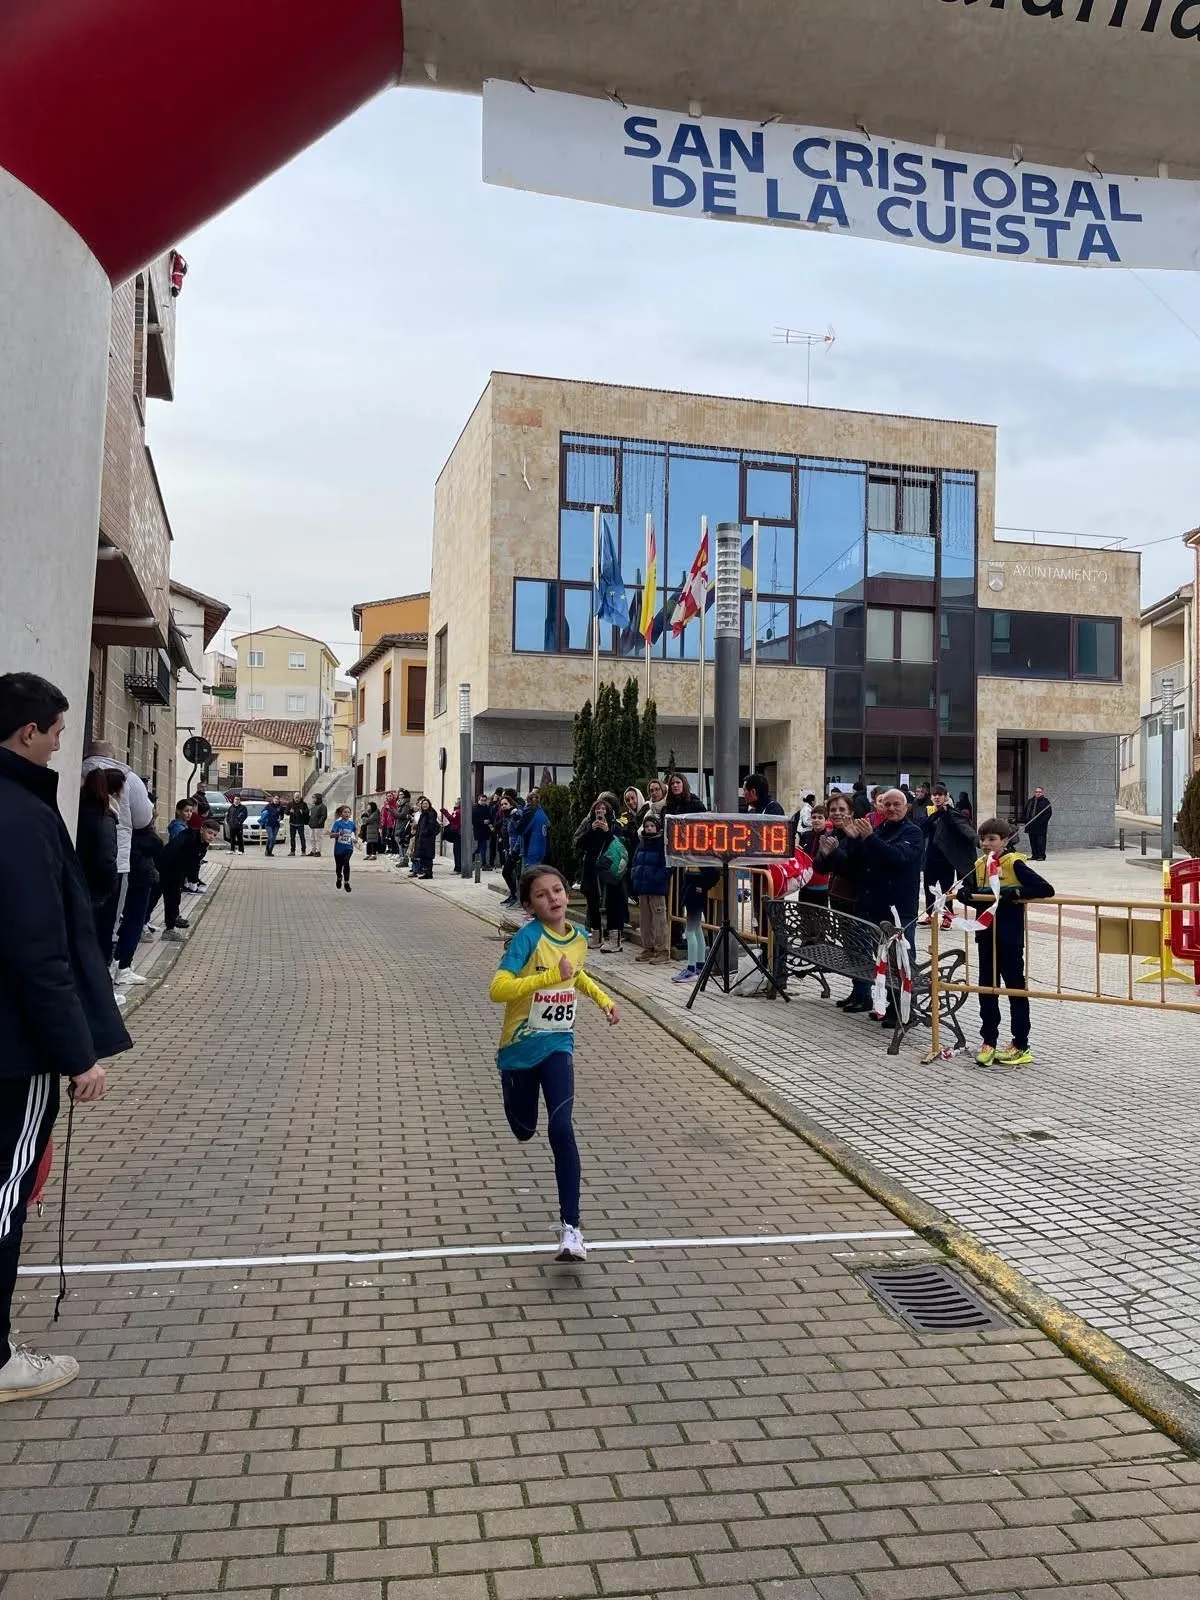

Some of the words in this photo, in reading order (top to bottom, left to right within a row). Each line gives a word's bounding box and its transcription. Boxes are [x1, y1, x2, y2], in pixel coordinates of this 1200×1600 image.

[623, 116, 763, 174] SAN
[792, 137, 1142, 222] CRISTOBAL
[651, 165, 737, 215] DE
[766, 178, 850, 228] LA
[877, 196, 1121, 262] CUESTA
[1012, 565, 1109, 583] AYUNTAMIENTO
[541, 1004, 574, 1021] 485
